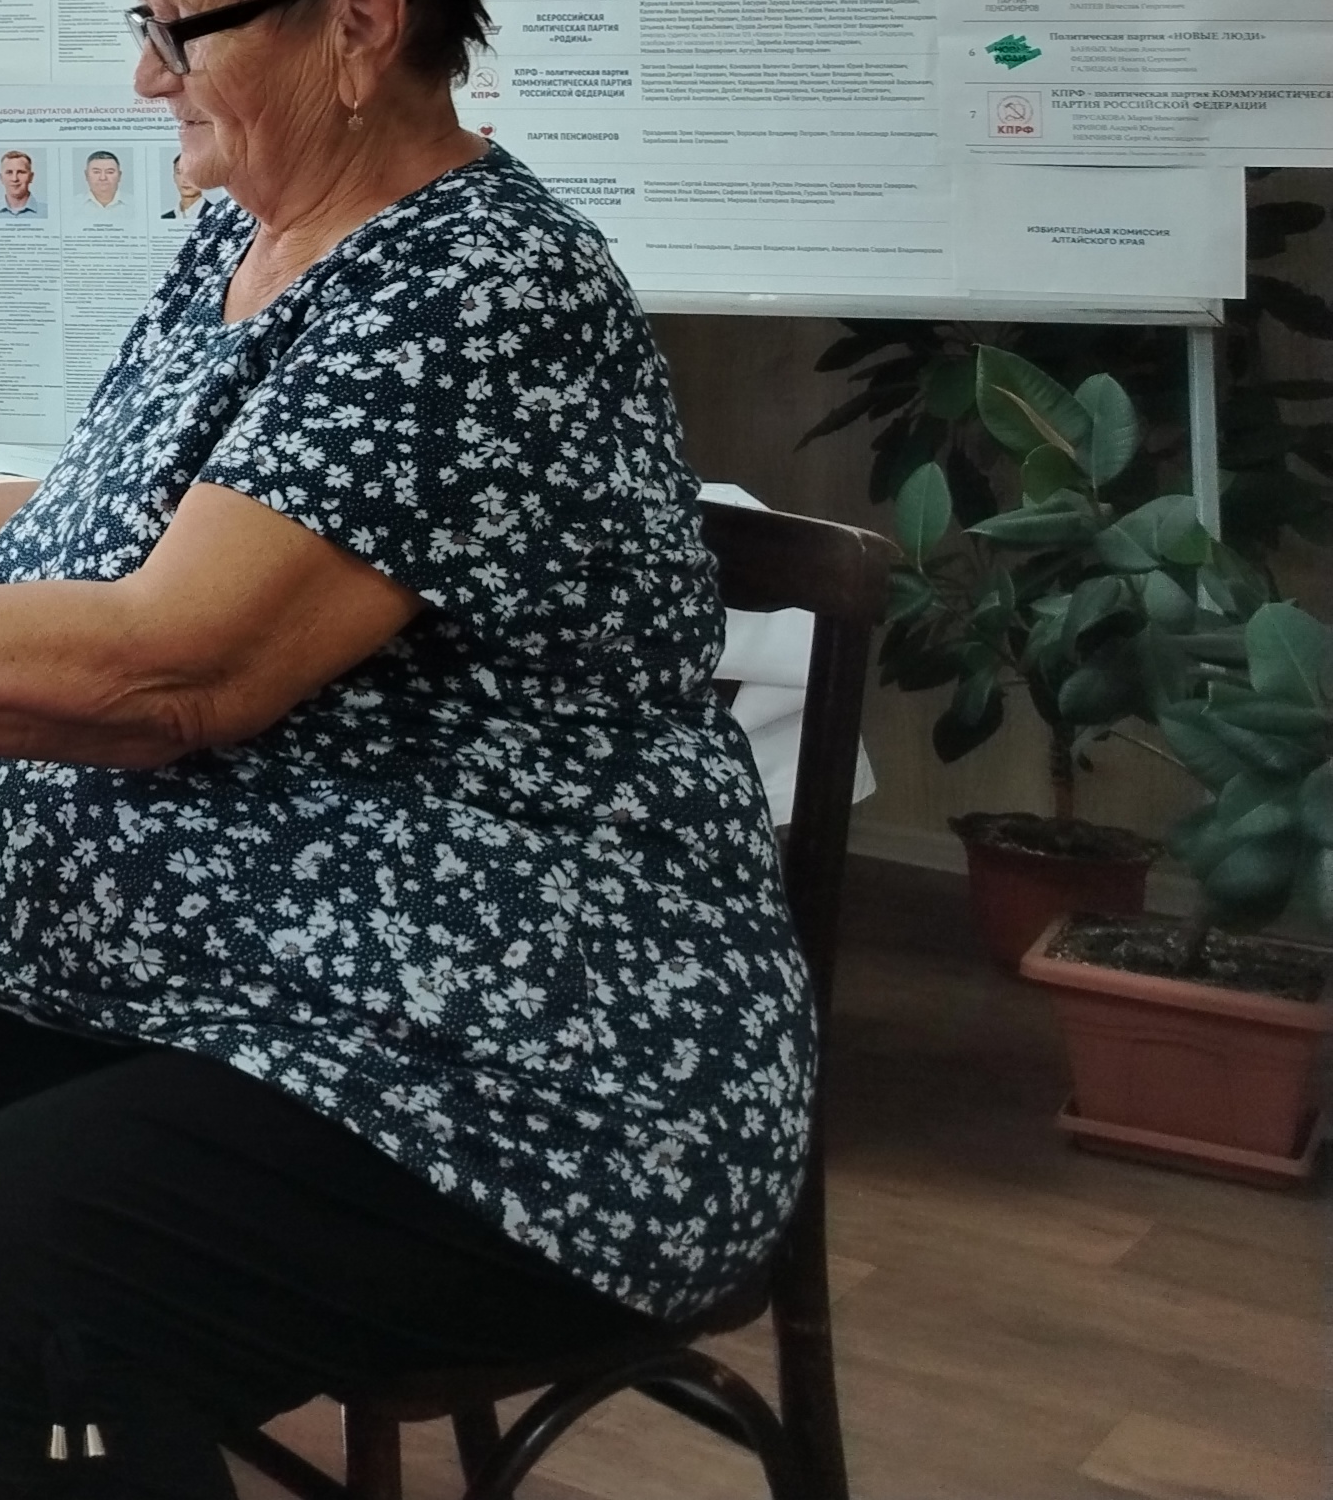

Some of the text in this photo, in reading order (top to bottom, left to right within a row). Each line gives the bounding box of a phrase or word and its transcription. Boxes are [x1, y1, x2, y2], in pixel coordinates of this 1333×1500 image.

[1212, 90, 1333, 99] КОММУНИСТИЧЕС
[997, 125, 1034, 134] КПРФ
[1027, 225, 1170, 236] ИЗБИРАТЕЛЬНАЯ КОМИССИЯ
[1052, 235, 1116, 245] АЛТАЙСКОГО
